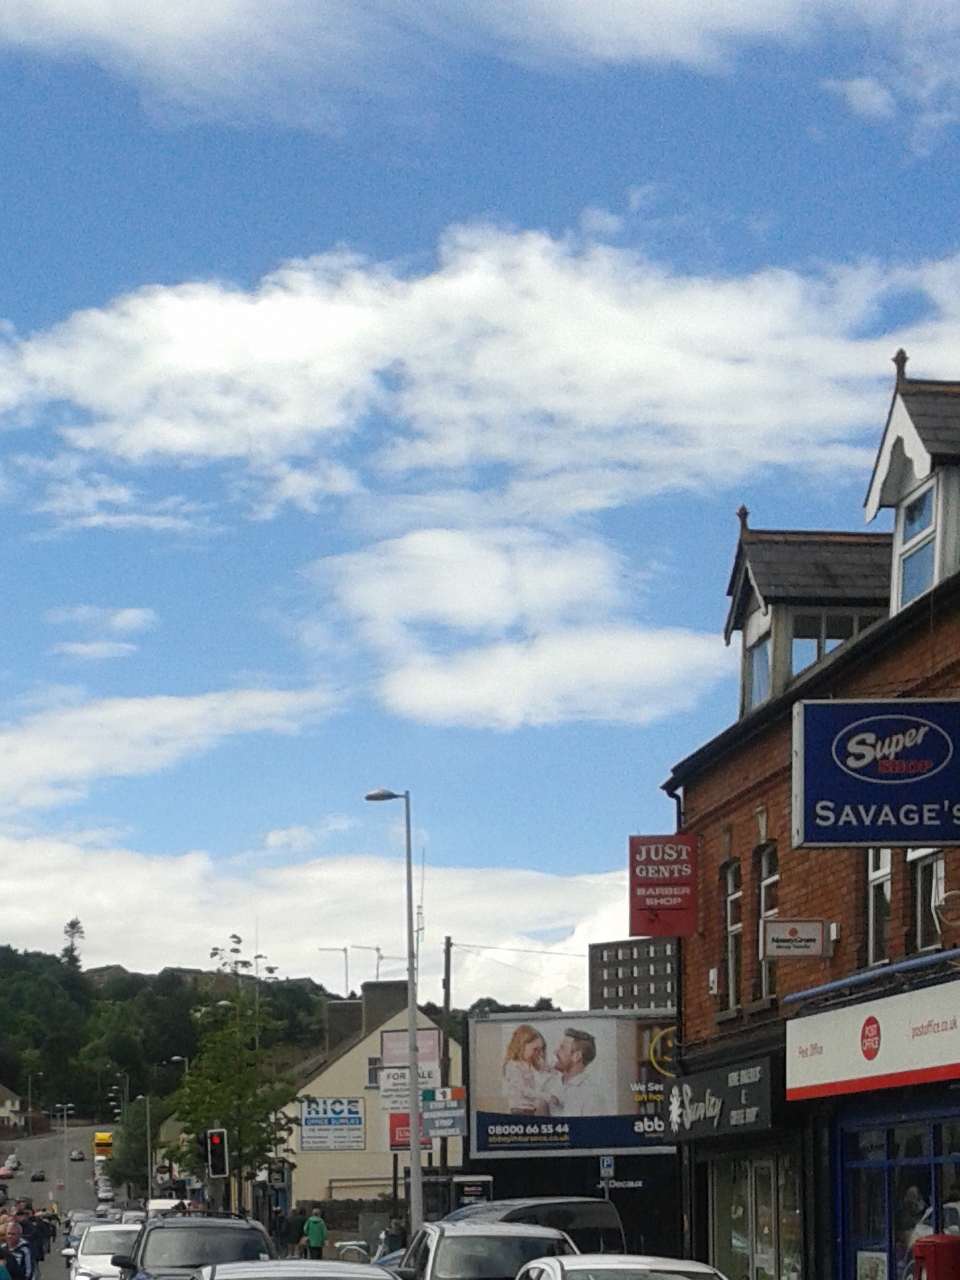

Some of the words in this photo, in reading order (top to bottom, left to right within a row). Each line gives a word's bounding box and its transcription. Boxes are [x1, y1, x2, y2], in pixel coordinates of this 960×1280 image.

[845, 724, 930, 768] Super
[877, 759, 934, 774] SHOP
[635, 843, 692, 862] JUST
[635, 863, 692, 878] GENTS
[636, 886, 691, 896] BARBER
[645, 897, 683, 906] SHOP
[864, 1023, 878, 1038] POST
[862, 1037, 880, 1051] OFFICE
[386, 1072, 407, 1081] FOR
[414, 1070, 434, 1079] ALE
[630, 1082, 646, 1092] We
[307, 1099, 359, 1115] RICE
[488, 1124, 524, 1135] 08000
[526, 1124, 539, 1134] 66
[540, 1124, 554, 1134] 55
